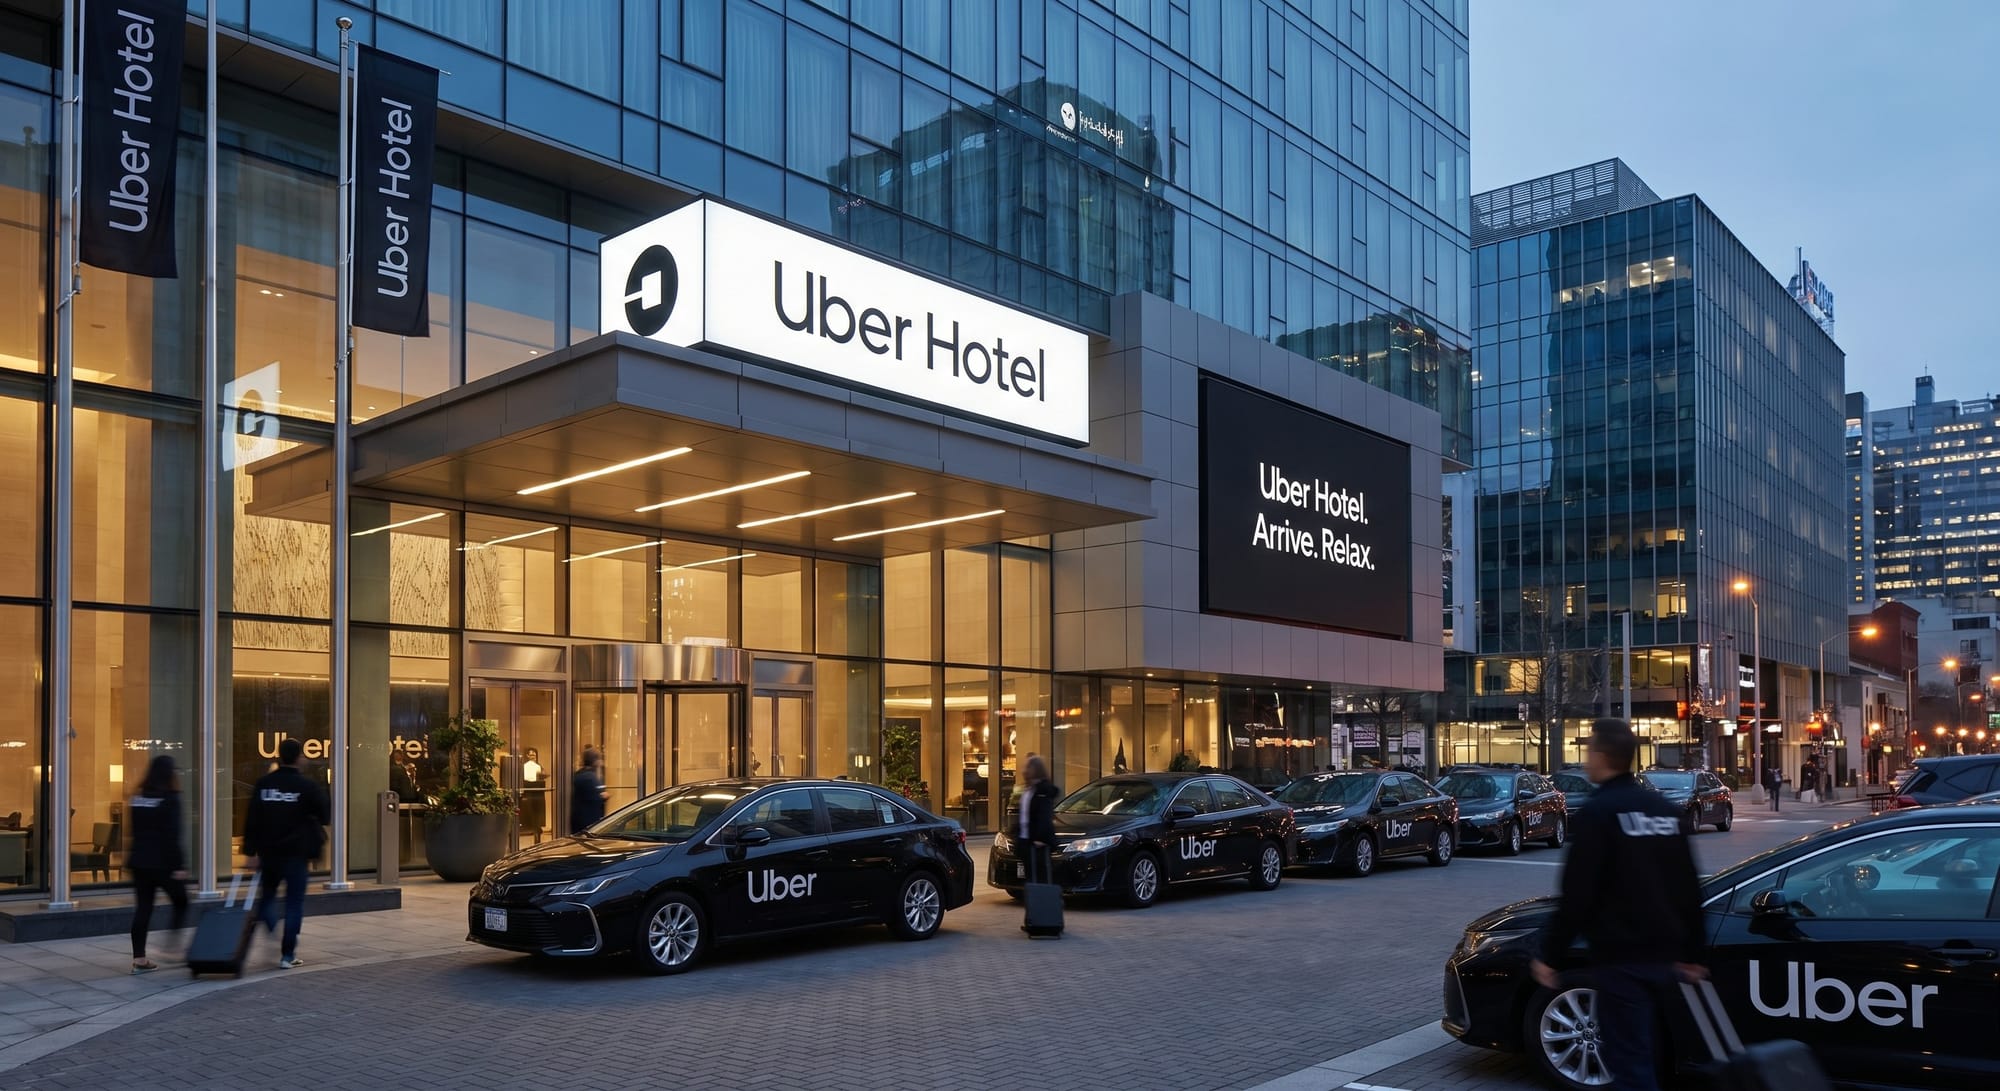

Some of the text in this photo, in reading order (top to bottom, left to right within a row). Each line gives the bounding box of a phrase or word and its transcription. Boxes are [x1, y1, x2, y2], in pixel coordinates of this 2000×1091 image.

[109, 9, 155, 233] Uber Hotel
[377, 97, 413, 299] Uber Hotel
[774, 260, 1045, 402] Uber Hotel
[1260, 462, 1368, 525] Uber Hotel.
[1252, 512, 1375, 571] Arrive. Relax.
[1180, 836, 1217, 860] Uber
[1386, 819, 1413, 839] Uber
[1616, 811, 1680, 837] Uber
[747, 869, 817, 903] Uber
[1749, 959, 1939, 1029] Uber
